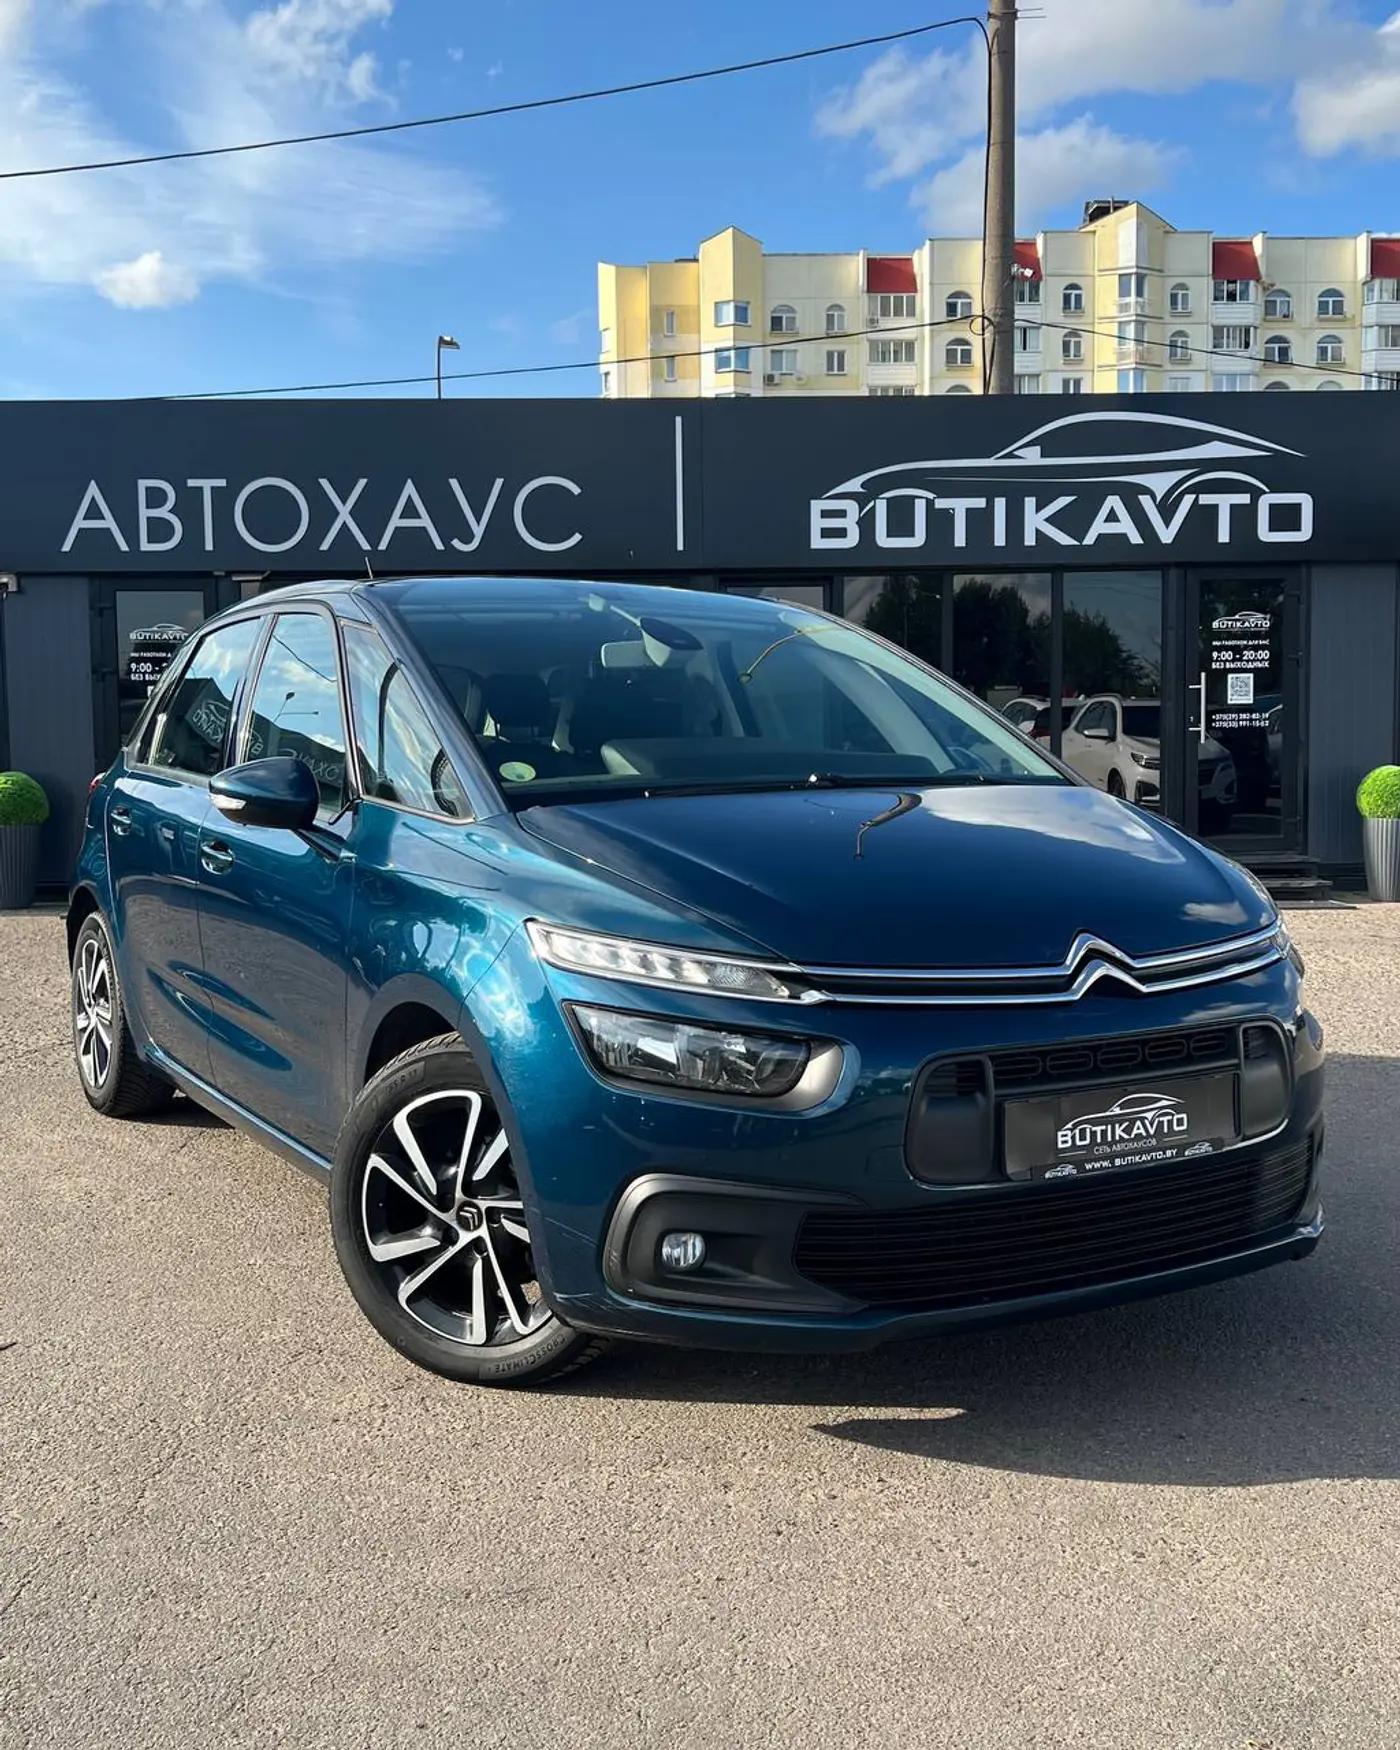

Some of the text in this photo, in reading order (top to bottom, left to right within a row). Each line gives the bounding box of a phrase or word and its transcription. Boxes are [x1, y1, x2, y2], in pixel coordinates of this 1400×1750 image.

[61, 476, 583, 552] АВТОХАУС
[810, 492, 1314, 549] BUTIKAVTO
[1212, 620, 1270, 629] BUTIKAVTO
[1212, 650, 1234, 661] 9:00
[1242, 649, 1270, 660] 20:00
[130, 662, 153, 673] 9:00
[1212, 660, 1270, 669] БЕЗ ВЫХОДНЫХ
[1057, 1112, 1188, 1149] BUTIKAVTO
[1094, 1138, 1157, 1155] СЕТЬ АВТОХАУСОВ
[1114, 1148, 1178, 1167] BUTIKAVTO.BY
